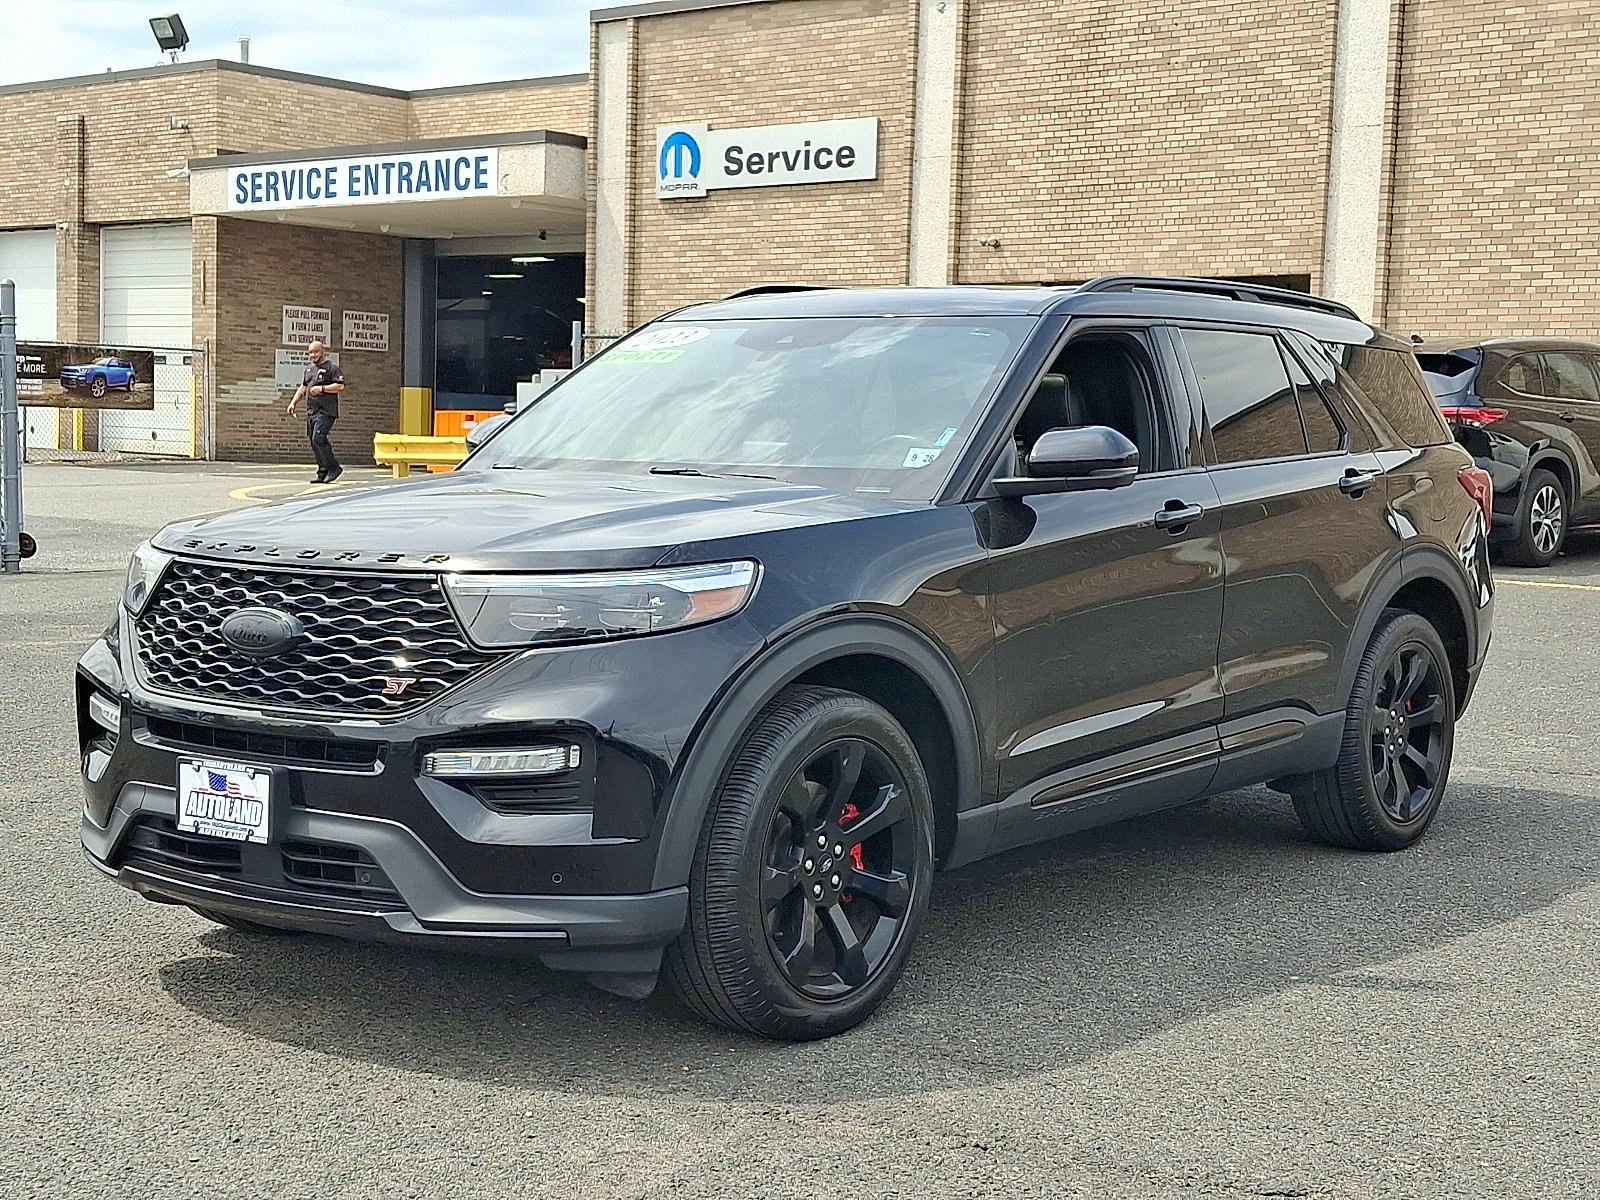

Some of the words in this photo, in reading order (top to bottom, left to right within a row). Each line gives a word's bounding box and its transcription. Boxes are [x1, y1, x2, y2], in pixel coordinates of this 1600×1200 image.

[724, 140, 856, 176] Service
[235, 166, 338, 204] SERVICE
[347, 155, 489, 197] ENTRANCE
[659, 183, 700, 193] MOPAR
[285, 309, 300, 319] PLEASE
[300, 310, 311, 320] PULL
[311, 310, 330, 321] FORWARD
[344, 312, 365, 321] PLEASE
[366, 314, 379, 322] PULL
[380, 315, 388, 323] UP
[295, 322, 307, 332] FORM
[311, 323, 324, 333] LANES
[353, 322, 361, 330] TO
[287, 334, 297, 343] INTO
[297, 334, 314, 344] SERVICE
[355, 332, 368, 340] WILL
[369, 333, 384, 341] OPEN
[344, 340, 387, 350] AUTOMATICALLY
[600, 351, 683, 363] SPORTY
[910, 453, 918, 462] 9
[183, 539, 450, 563] EXPLORER
[382, 677, 417, 695] ST
[185, 790, 264, 827] AUTOLAND
[1034, 792, 1122, 821] EXPLORER
[197, 828, 247, 841] AUTOLAND
